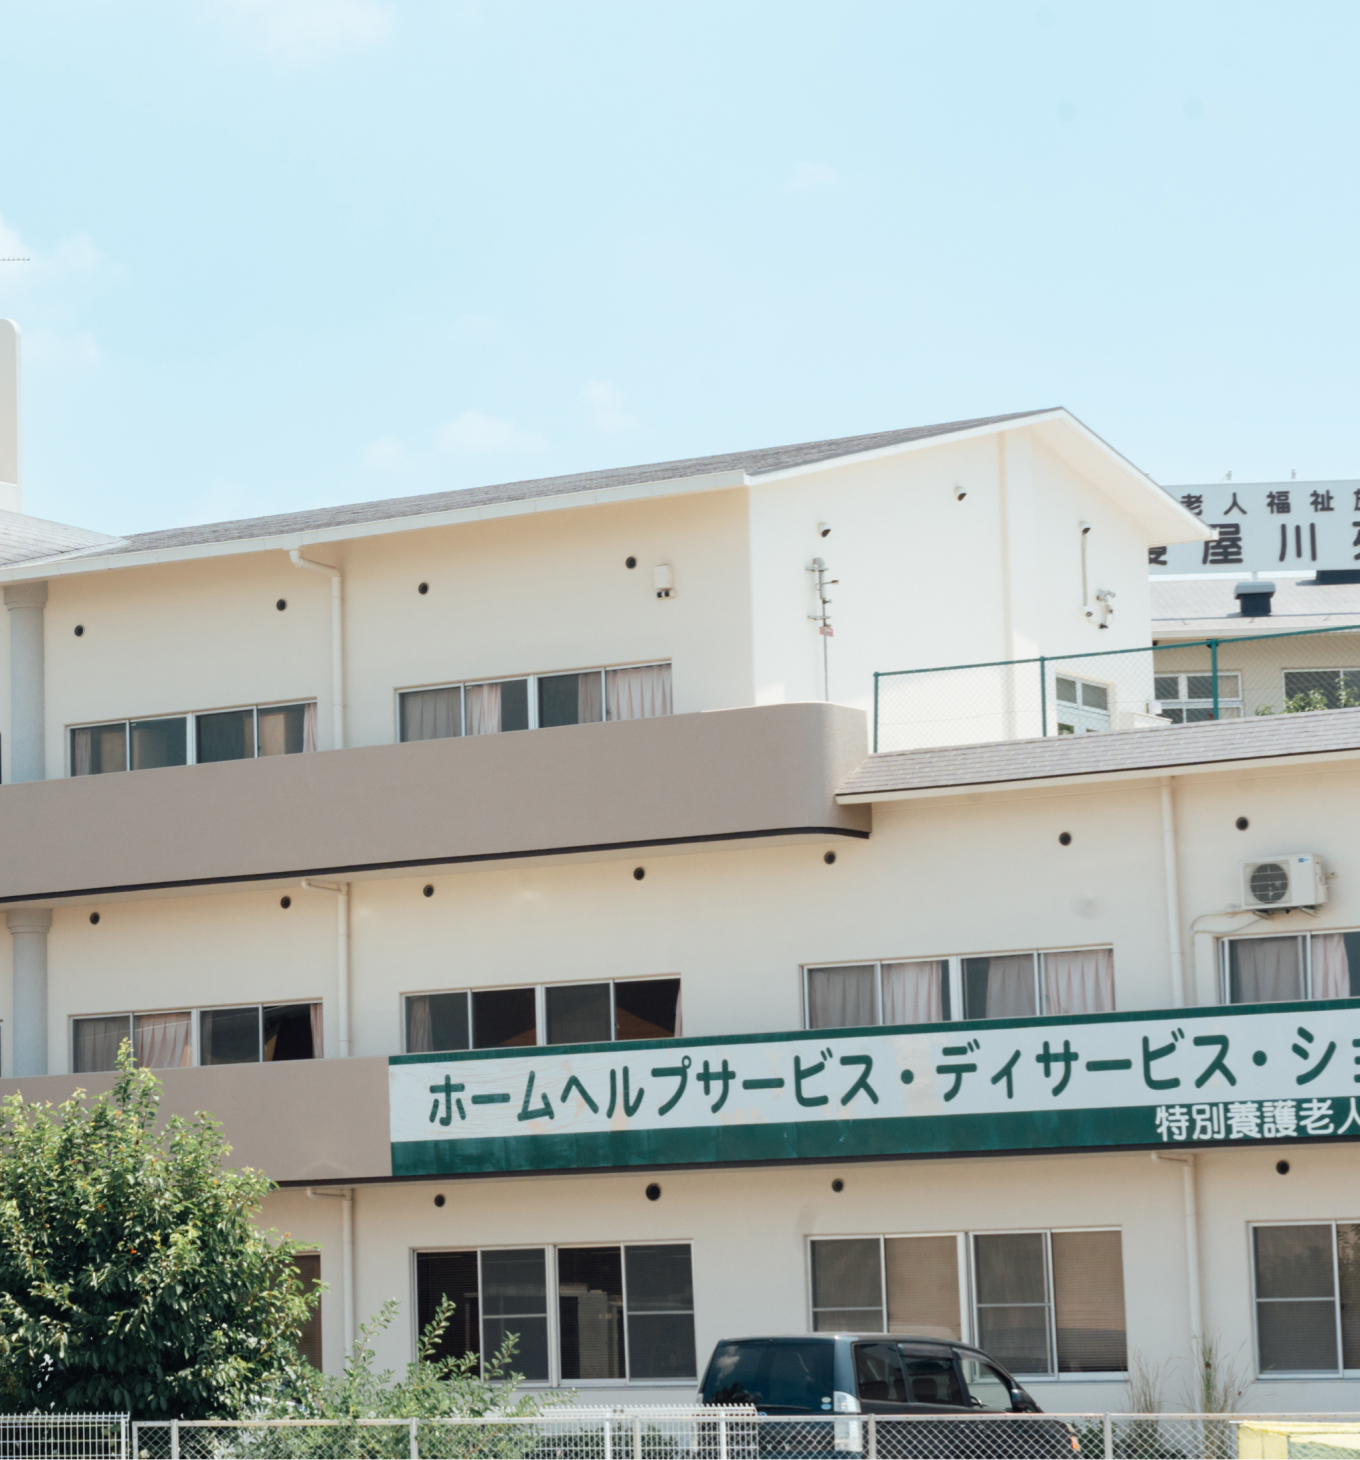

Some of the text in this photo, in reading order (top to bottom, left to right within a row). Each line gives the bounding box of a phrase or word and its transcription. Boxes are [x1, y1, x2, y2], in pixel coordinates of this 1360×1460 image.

[1180, 488, 1360, 516] 老人福祉
[1148, 521, 1360, 566] 屋川
[428, 1026, 1360, 1127] ホームヘルプサービス・ディサービス・シ
[1155, 1097, 1360, 1142] 特別養護老人
